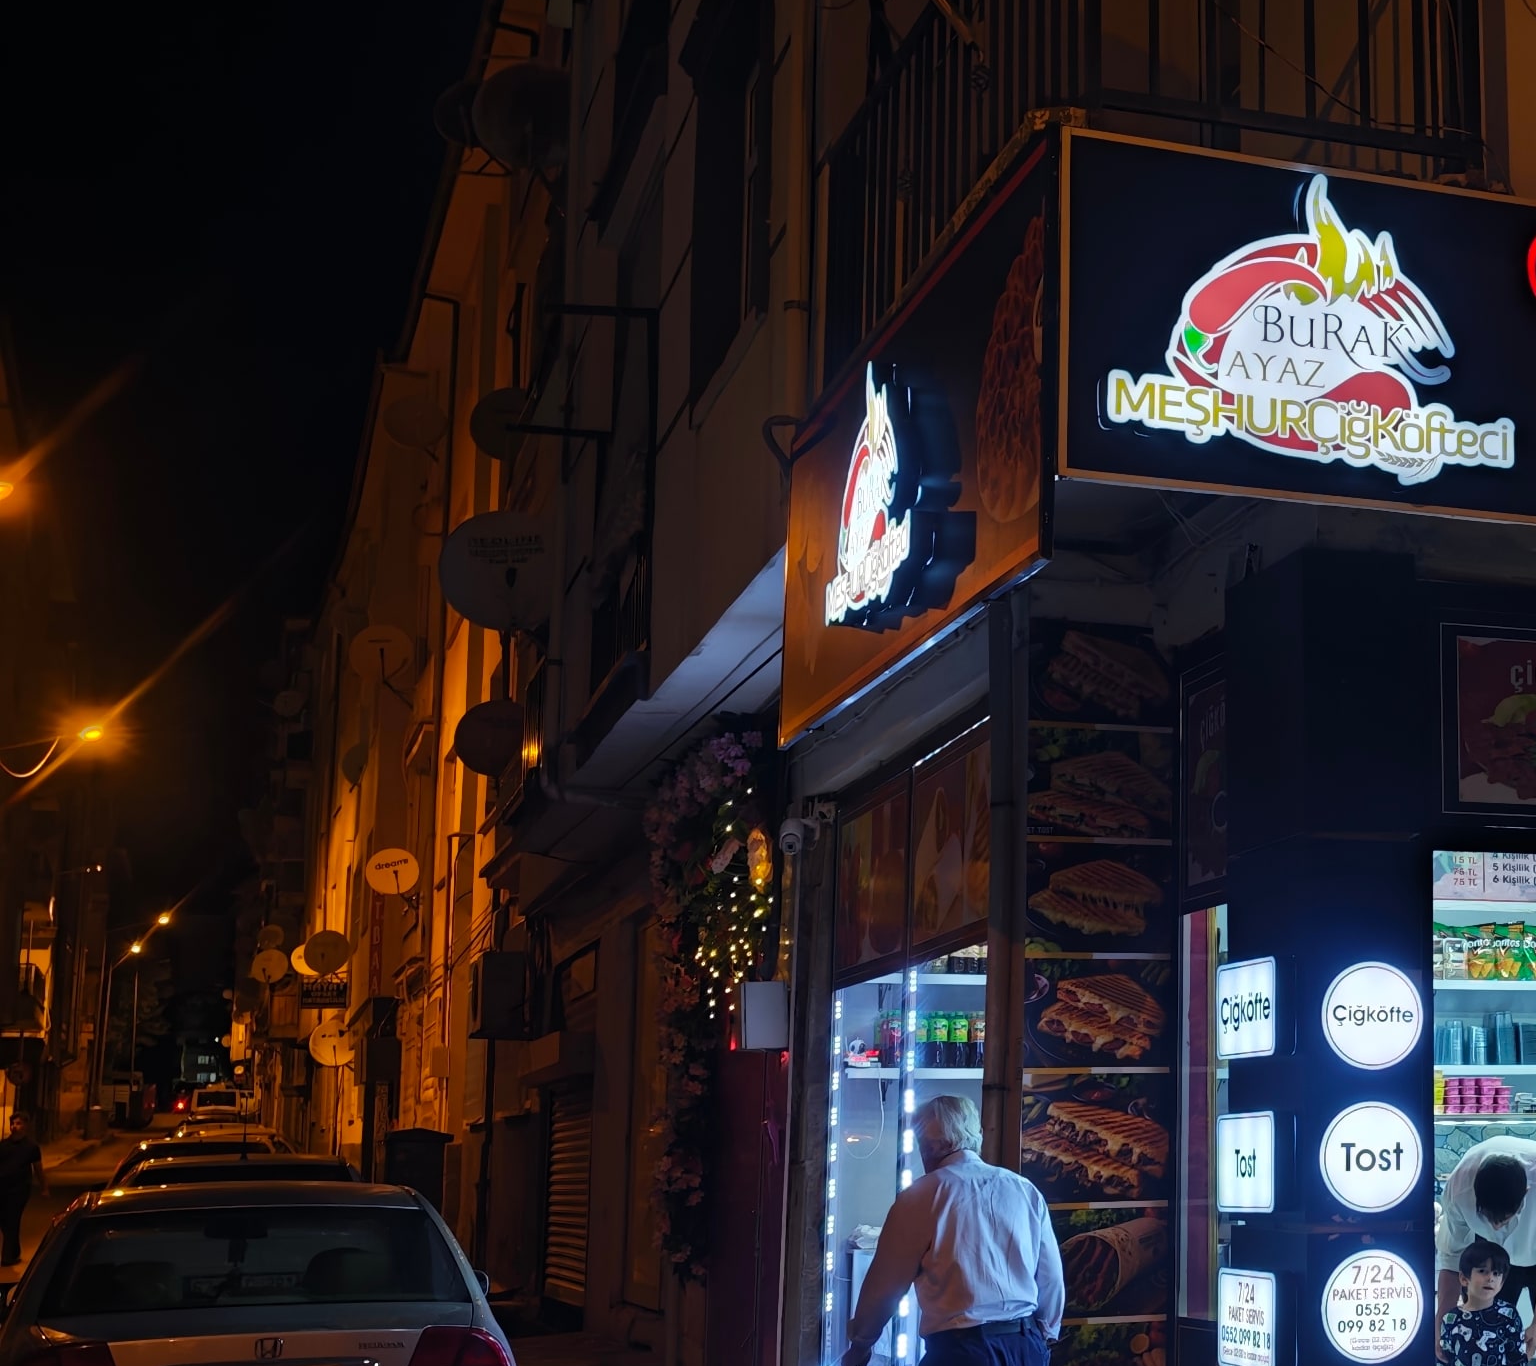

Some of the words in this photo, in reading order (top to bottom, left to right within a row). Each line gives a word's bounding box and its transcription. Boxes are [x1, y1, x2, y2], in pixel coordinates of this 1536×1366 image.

[1225, 350, 1326, 389] AYAZ
[1468, 856, 1477, 865] TL
[1492, 863, 1499, 871] 5
[1502, 863, 1530, 873] Kişilik
[1468, 868, 1477, 876] TL
[1468, 878, 1477, 886] TL
[1492, 875, 1499, 883] 6
[1502, 875, 1531, 886] Kişilik
[1220, 990, 1271, 1033] Çiğköfte
[1332, 1003, 1414, 1028] Çiğköfte
[1234, 1148, 1257, 1179] Tost
[1341, 1141, 1404, 1173] Tost
[1352, 1263, 1396, 1286] 7/24
[1237, 1281, 1255, 1304] 7/24
[1332, 1288, 1369, 1302] PAKET
[1372, 1285, 1413, 1300] SERVİS
[1228, 1305, 1245, 1323] PAKET
[1245, 1307, 1265, 1327] SERVİS
[1355, 1303, 1390, 1317] 0552
[1338, 1320, 1364, 1333] 099
[1369, 1319, 1385, 1332] 82
[1392, 1318, 1407, 1331] 18
[1221, 1324, 1238, 1343] 0552
[1239, 1329, 1251, 1346] 099
[1252, 1331, 1261, 1348] 82
[1262, 1332, 1271, 1350] 18
